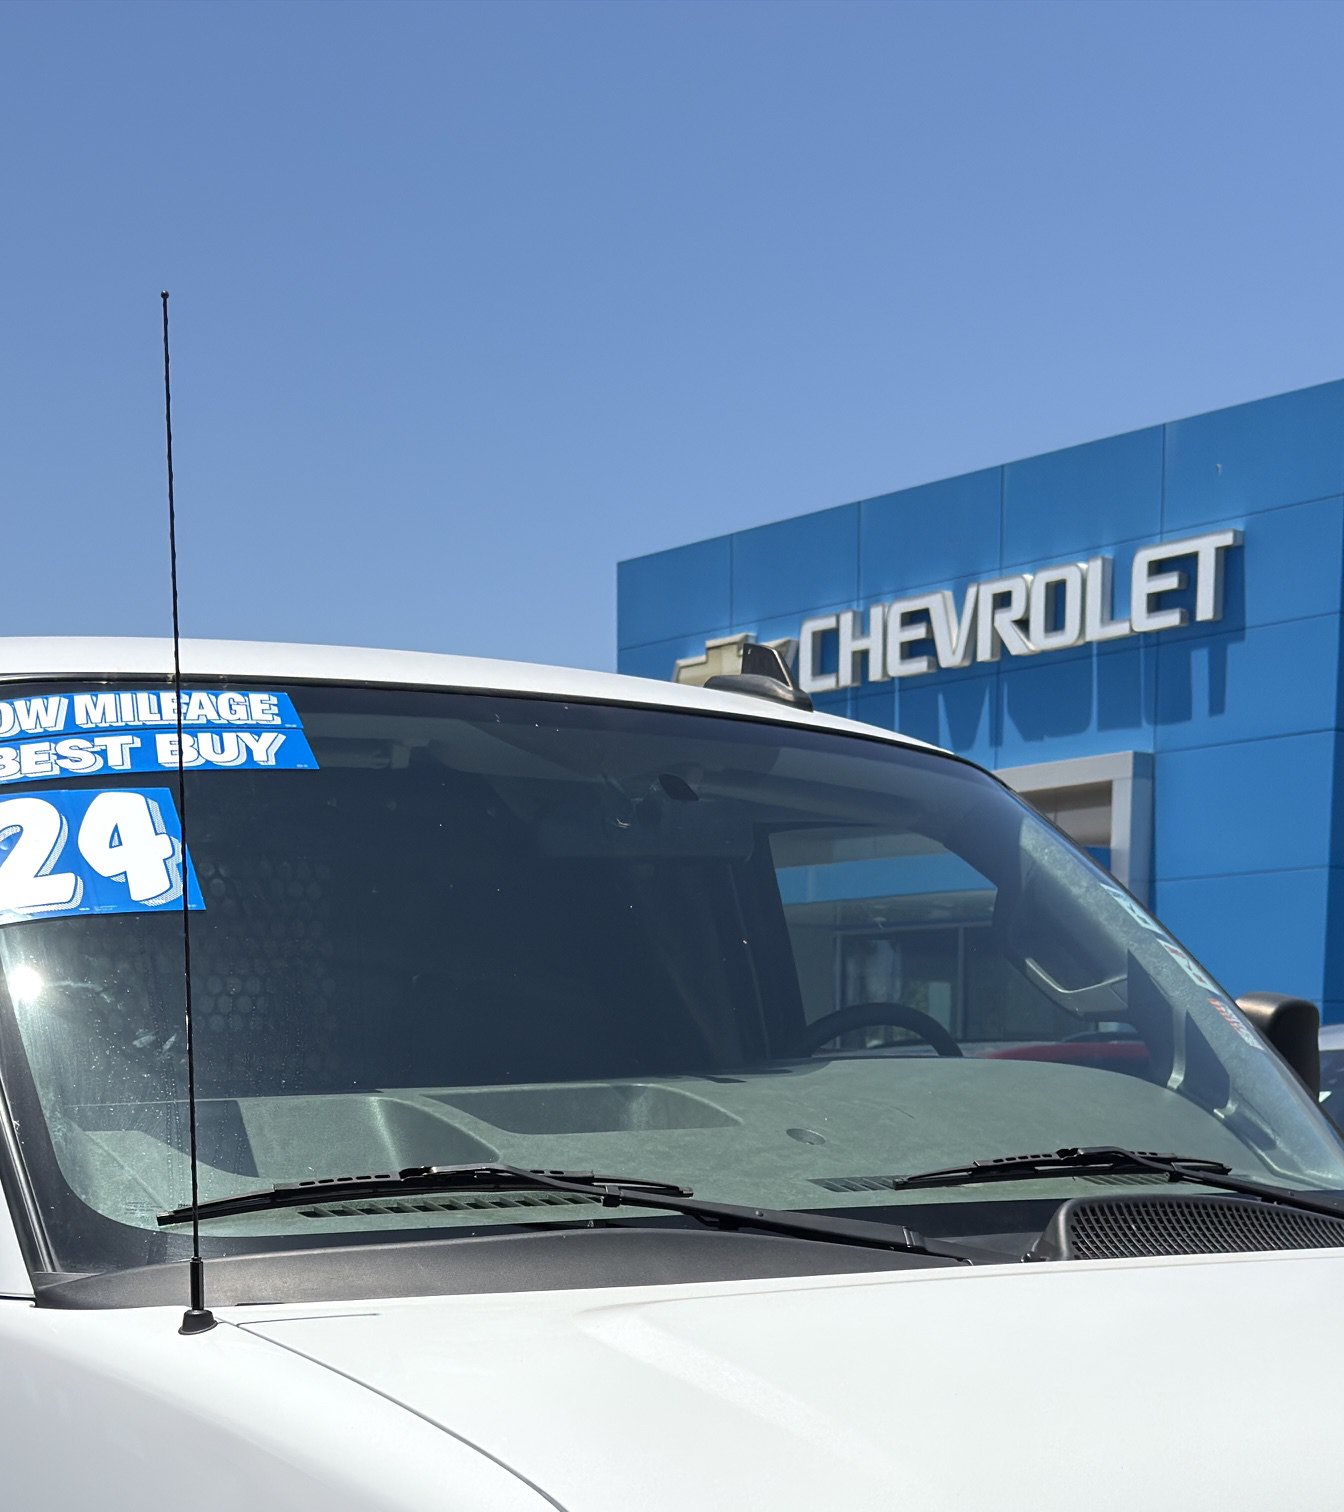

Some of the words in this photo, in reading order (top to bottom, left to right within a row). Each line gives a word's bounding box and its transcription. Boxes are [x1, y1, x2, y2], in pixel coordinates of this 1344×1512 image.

[798, 528, 1244, 694] CHEVROLET
[74, 691, 283, 728] MILEAGE
[156, 732, 287, 768] BUY
